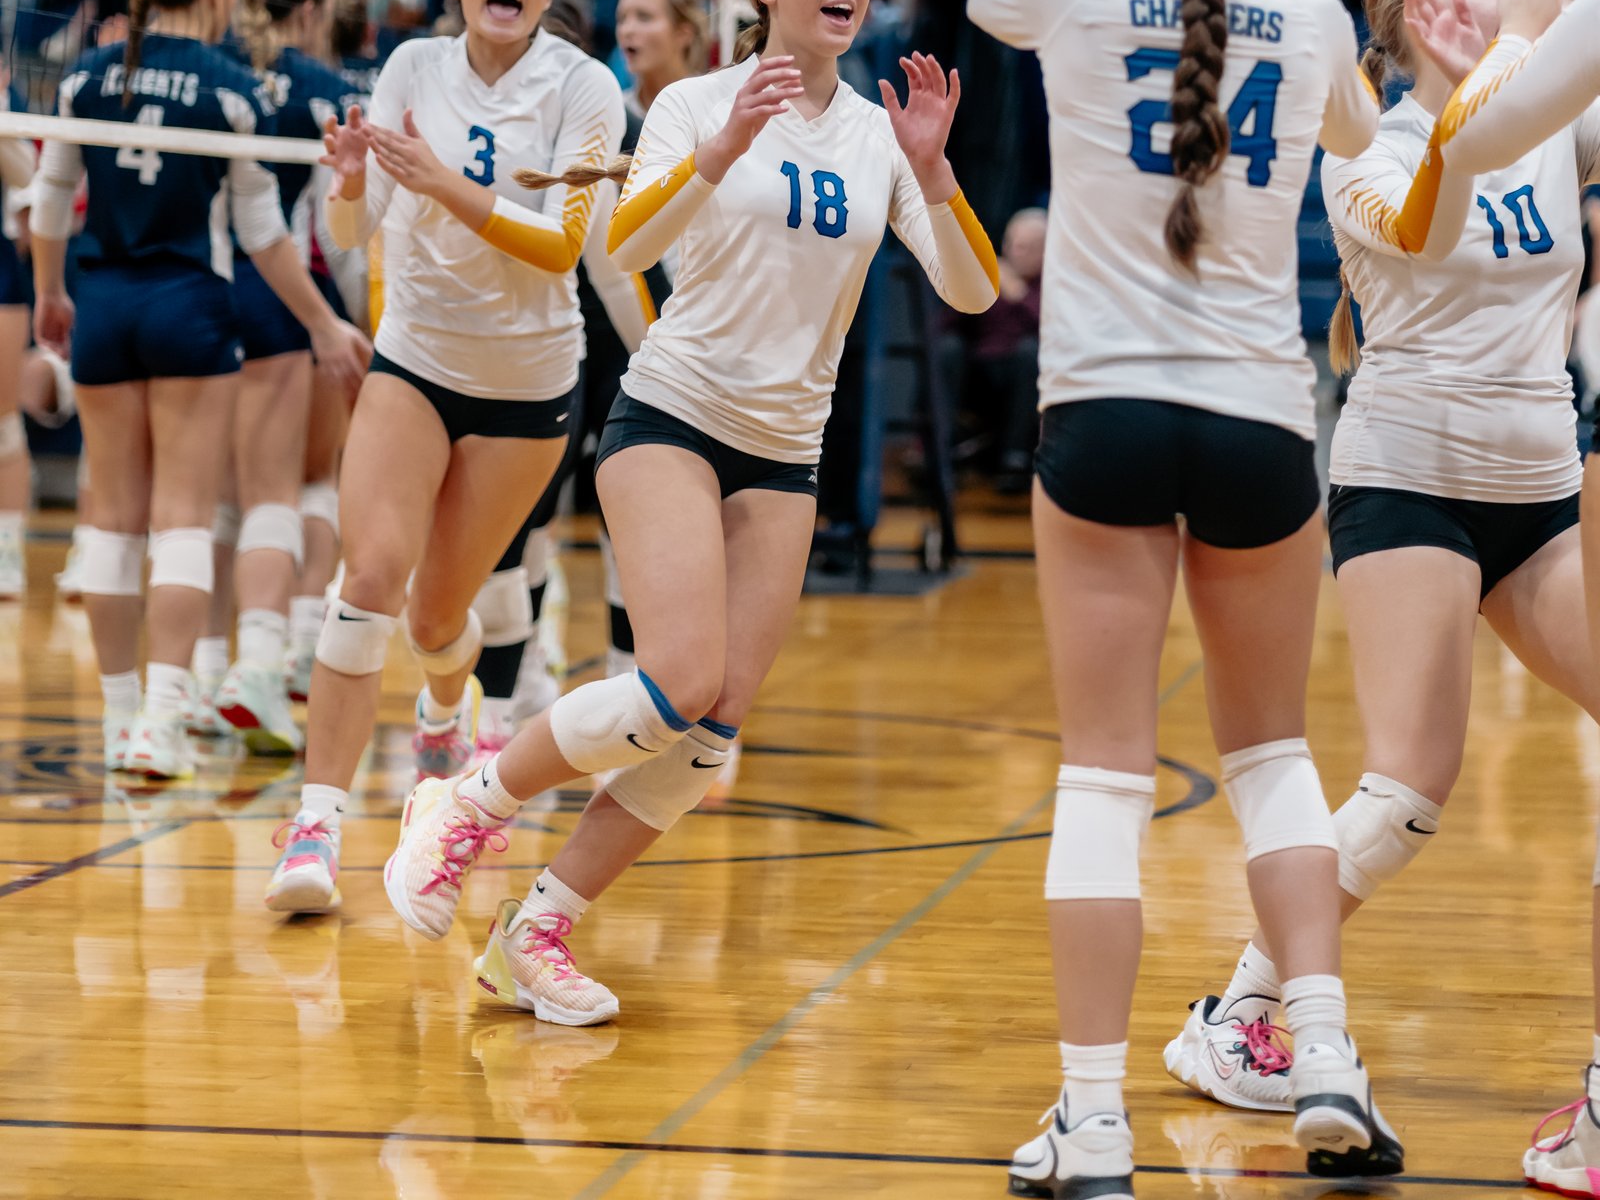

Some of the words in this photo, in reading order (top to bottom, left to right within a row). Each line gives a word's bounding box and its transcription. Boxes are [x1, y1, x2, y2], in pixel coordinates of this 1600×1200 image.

[116, 104, 165, 186] 4
[463, 125, 496, 187] 3
[1124, 46, 1283, 187] 24
[780, 160, 849, 239] 18
[1476, 185, 1554, 258] 10
